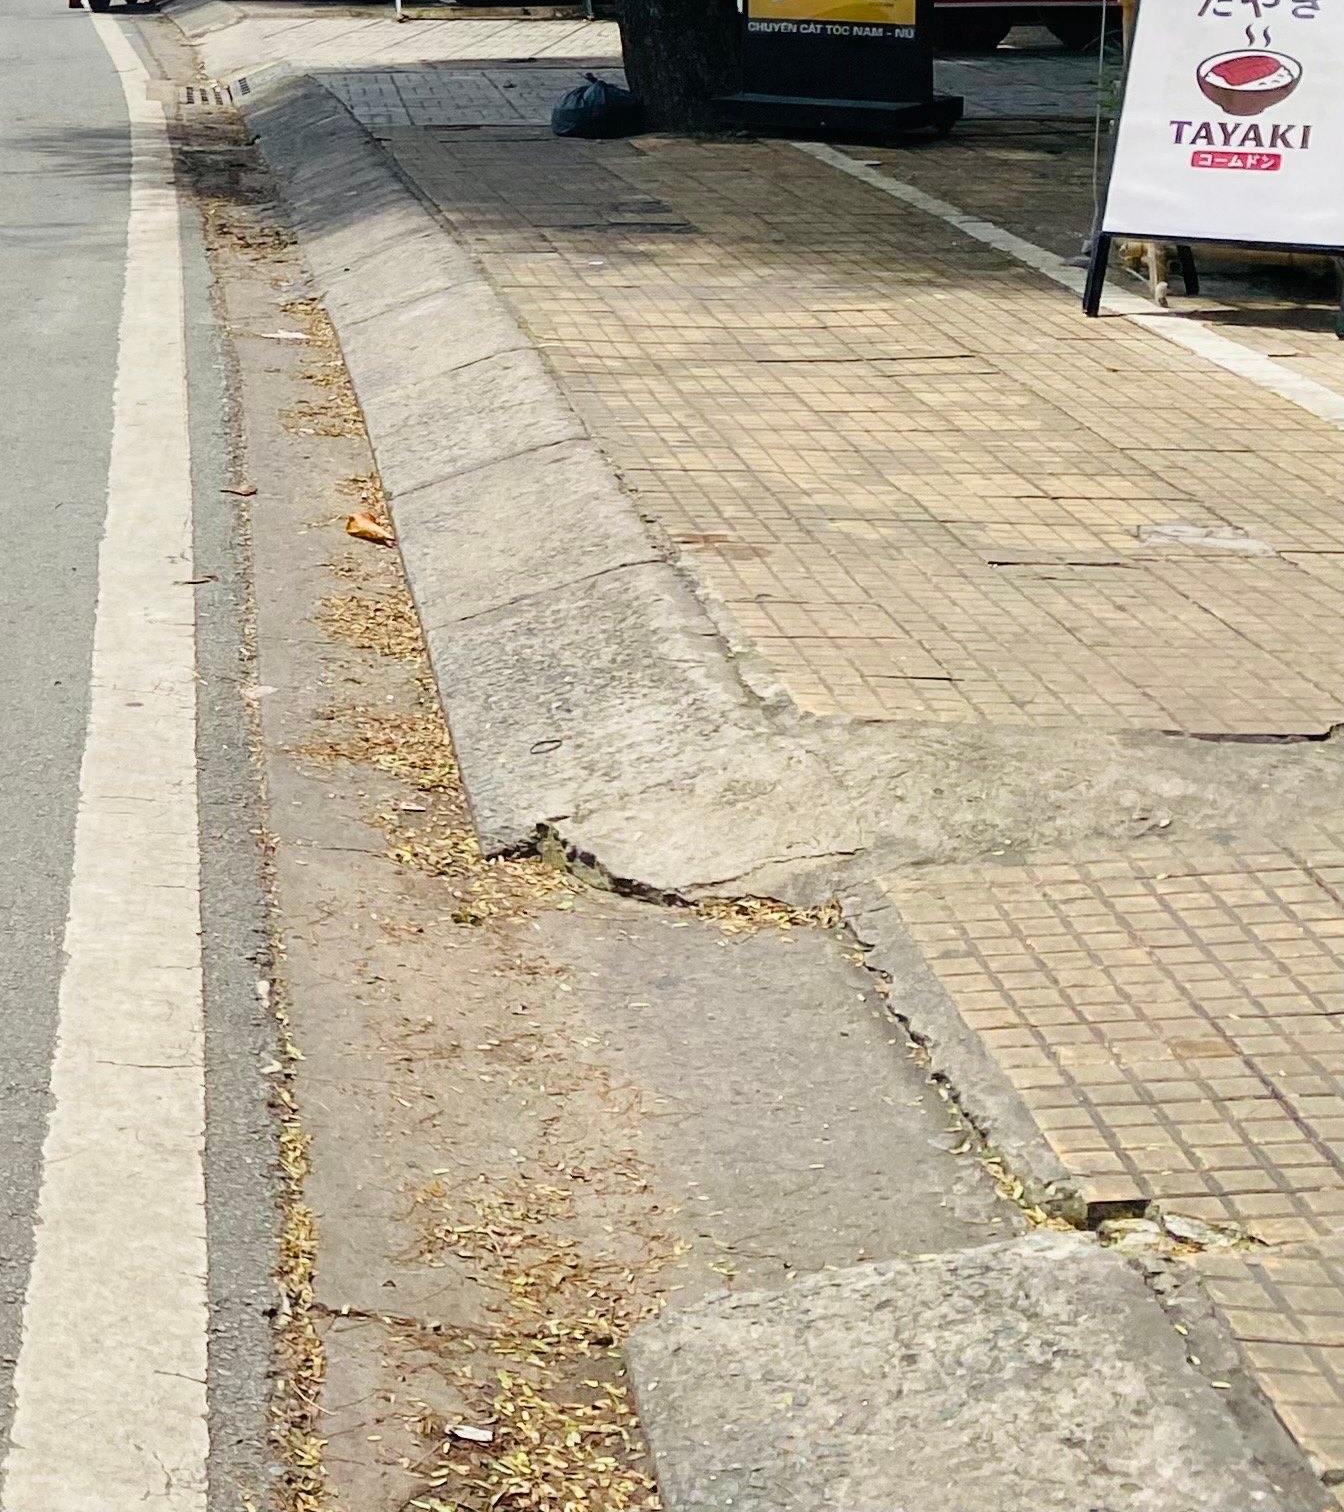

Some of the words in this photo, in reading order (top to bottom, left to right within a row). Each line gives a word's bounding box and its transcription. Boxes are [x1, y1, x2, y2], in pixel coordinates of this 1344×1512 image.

[747, 21, 798, 34] CHUYÊN
[853, 26, 884, 38] NAM
[1169, 119, 1314, 150] TAYAKI
